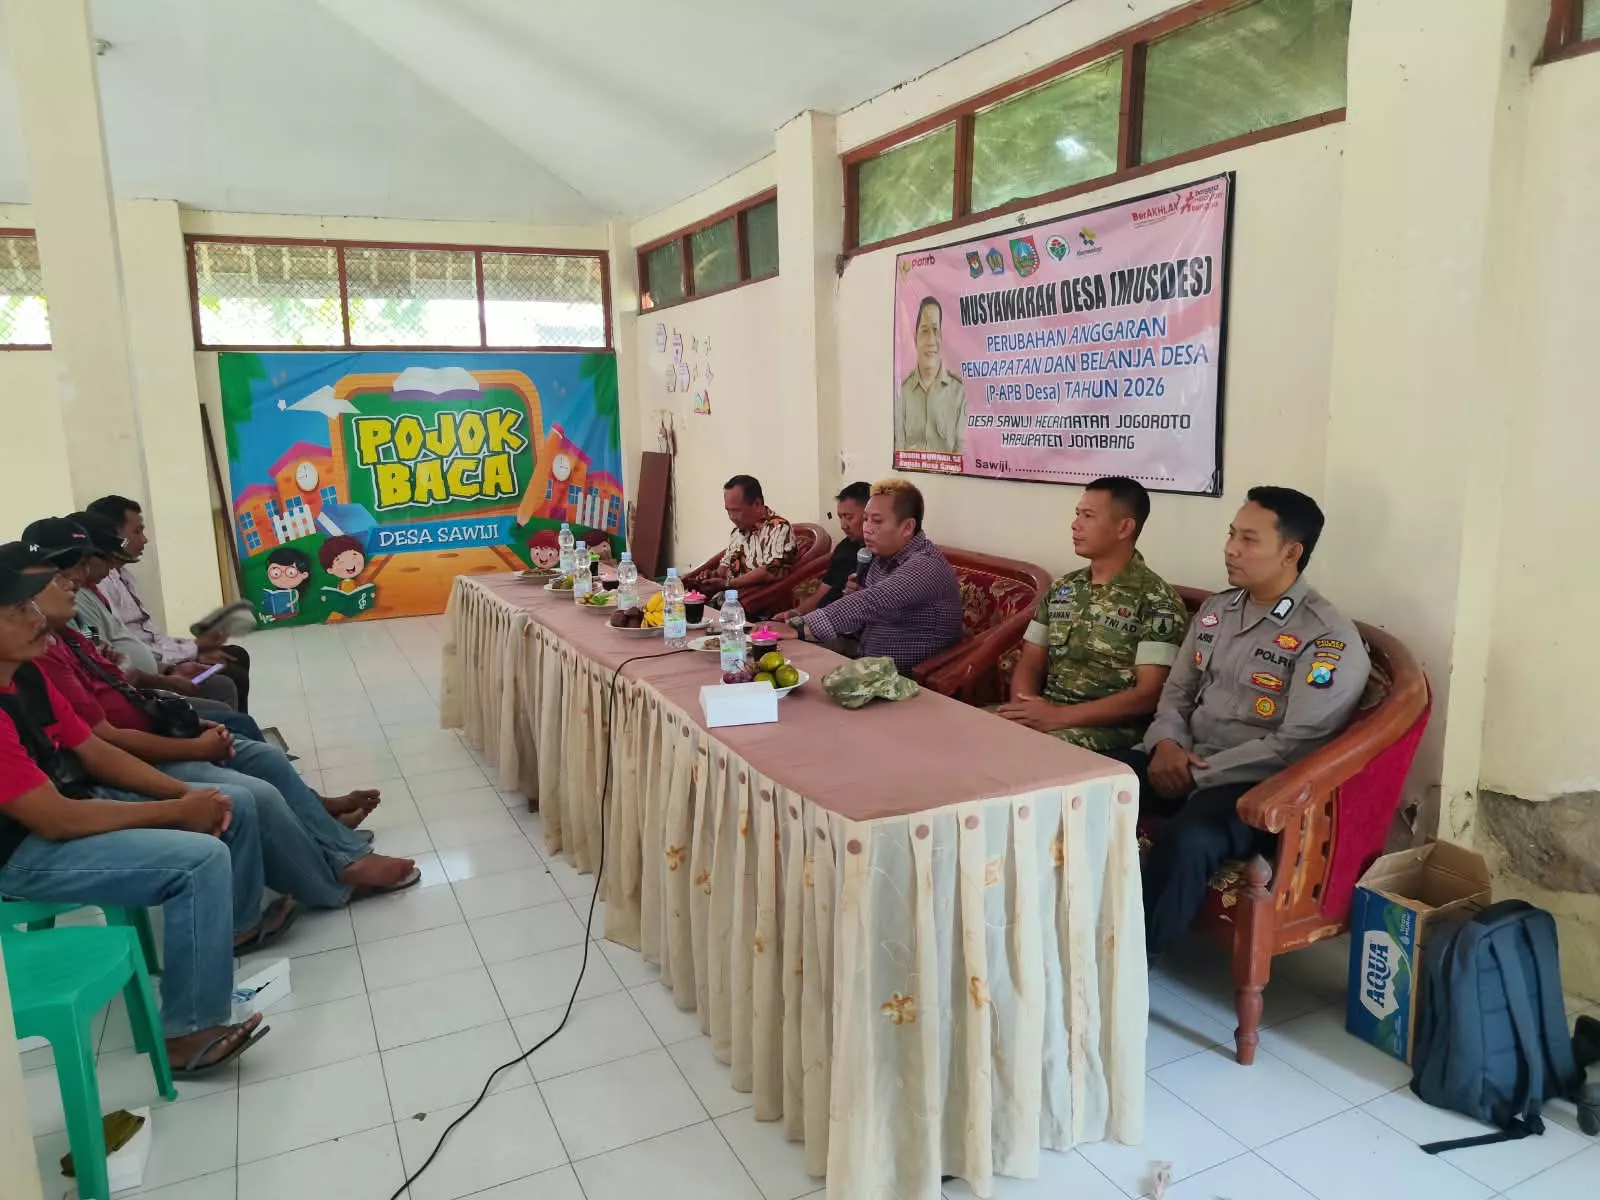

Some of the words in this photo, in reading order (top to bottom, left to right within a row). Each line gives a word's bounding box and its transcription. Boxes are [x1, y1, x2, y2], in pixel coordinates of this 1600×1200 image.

[960, 282, 1058, 327] MUSYAWARAH
[1060, 273, 1107, 315] DESA
[986, 327, 1067, 353] PERUBAHAN
[1068, 315, 1168, 347] ANGGARAN
[961, 357, 1043, 378] PENDAPATAN
[1044, 353, 1077, 375] DAN
[1080, 347, 1156, 373] BELANJA
[1161, 343, 1209, 367] DESA
[986, 383, 1023, 404] (P-APB
[1025, 382, 1061, 403] Desa)
[1064, 378, 1119, 401] TAHUN
[1122, 375, 1166, 398] 2026
[354, 409, 527, 466] POJOK
[967, 414, 994, 428] DESA
[1034, 414, 1111, 430] KECAMATAN
[1114, 413, 1192, 430] JOGOROTO
[1001, 432, 1063, 449] KABUPATEN
[1066, 434, 1136, 451] JOMBANG
[372, 451, 519, 511] BACA
[379, 529, 434, 547] DESA
[437, 524, 500, 543] SAWIJI
[1104, 616, 1119, 629] TNI
[1120, 622, 1138, 634] AD
[1254, 648, 1295, 669] POLRI
[1366, 943, 1390, 1009] AQUA
